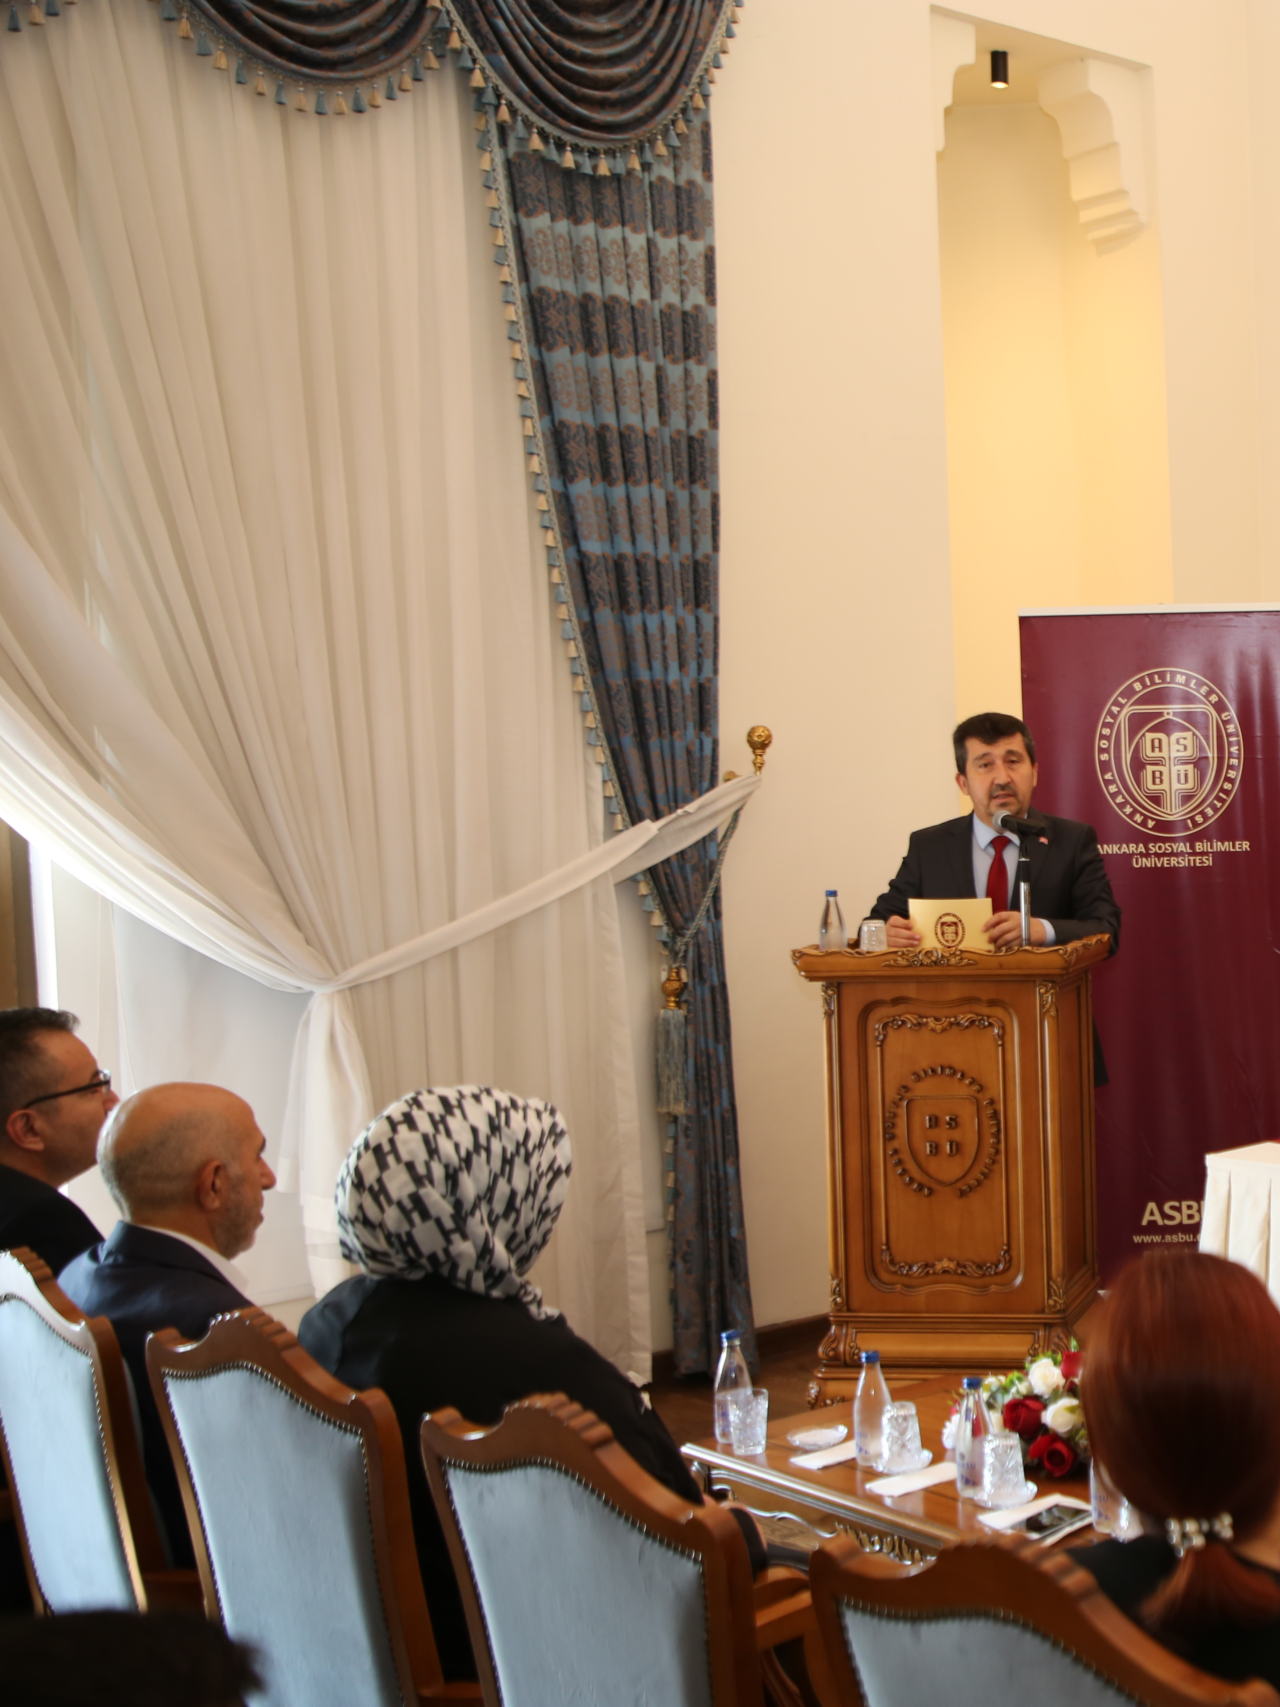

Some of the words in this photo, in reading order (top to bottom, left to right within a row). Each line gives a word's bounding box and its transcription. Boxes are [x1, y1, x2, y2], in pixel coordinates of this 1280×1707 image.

[1133, 671, 1219, 705] BİLİMLER
[1100, 696, 1128, 762] SOSYAL
[1187, 711, 1240, 830] ÜNİVERSİTESİ
[1104, 772, 1156, 829] ANKARA
[1132, 854, 1213, 868] ÜNİVERSİTESİ
[1149, 842, 1192, 854] SOSYAL
[1195, 839, 1251, 853] BİLİMLER
[1141, 1201, 1204, 1226] ASB
